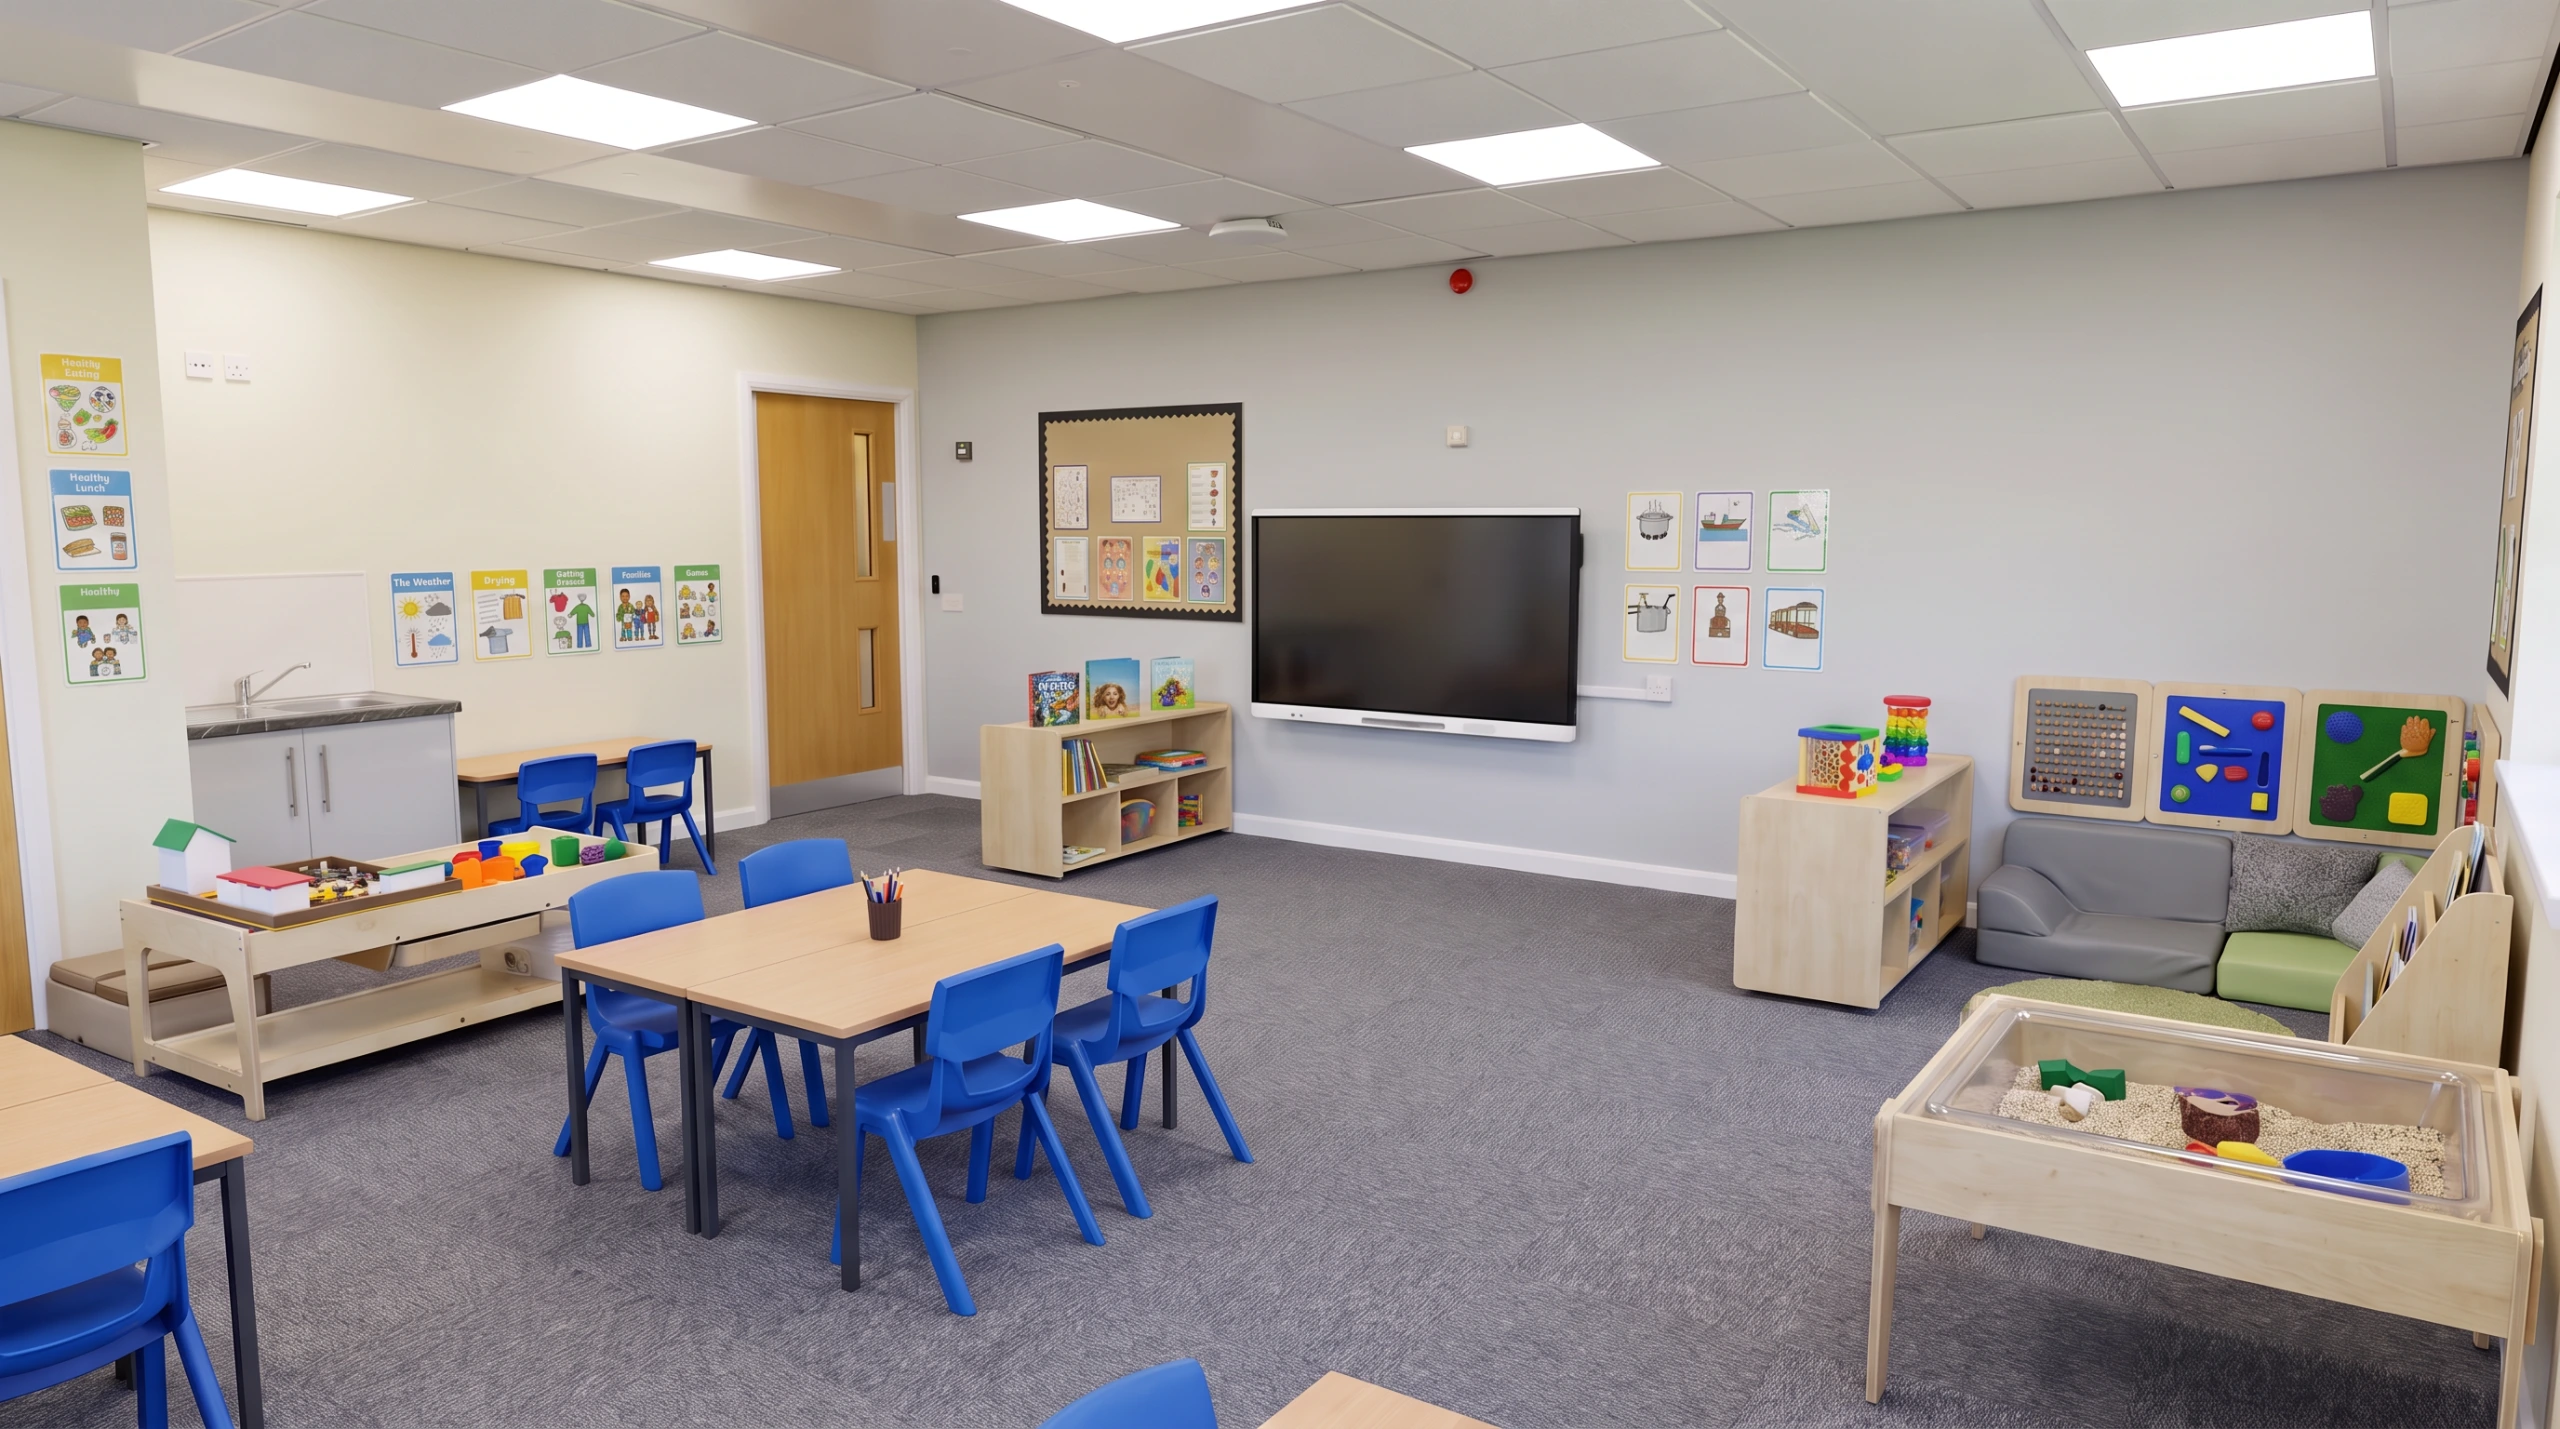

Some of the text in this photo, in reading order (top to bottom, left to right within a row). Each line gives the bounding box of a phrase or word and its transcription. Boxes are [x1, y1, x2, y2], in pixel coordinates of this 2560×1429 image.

[64, 368, 100, 380] Eating
[69, 473, 110, 485] Healthy
[75, 484, 106, 492] Lunch
[393, 576, 451, 588] The Weather
[483, 576, 516, 587] Drying
